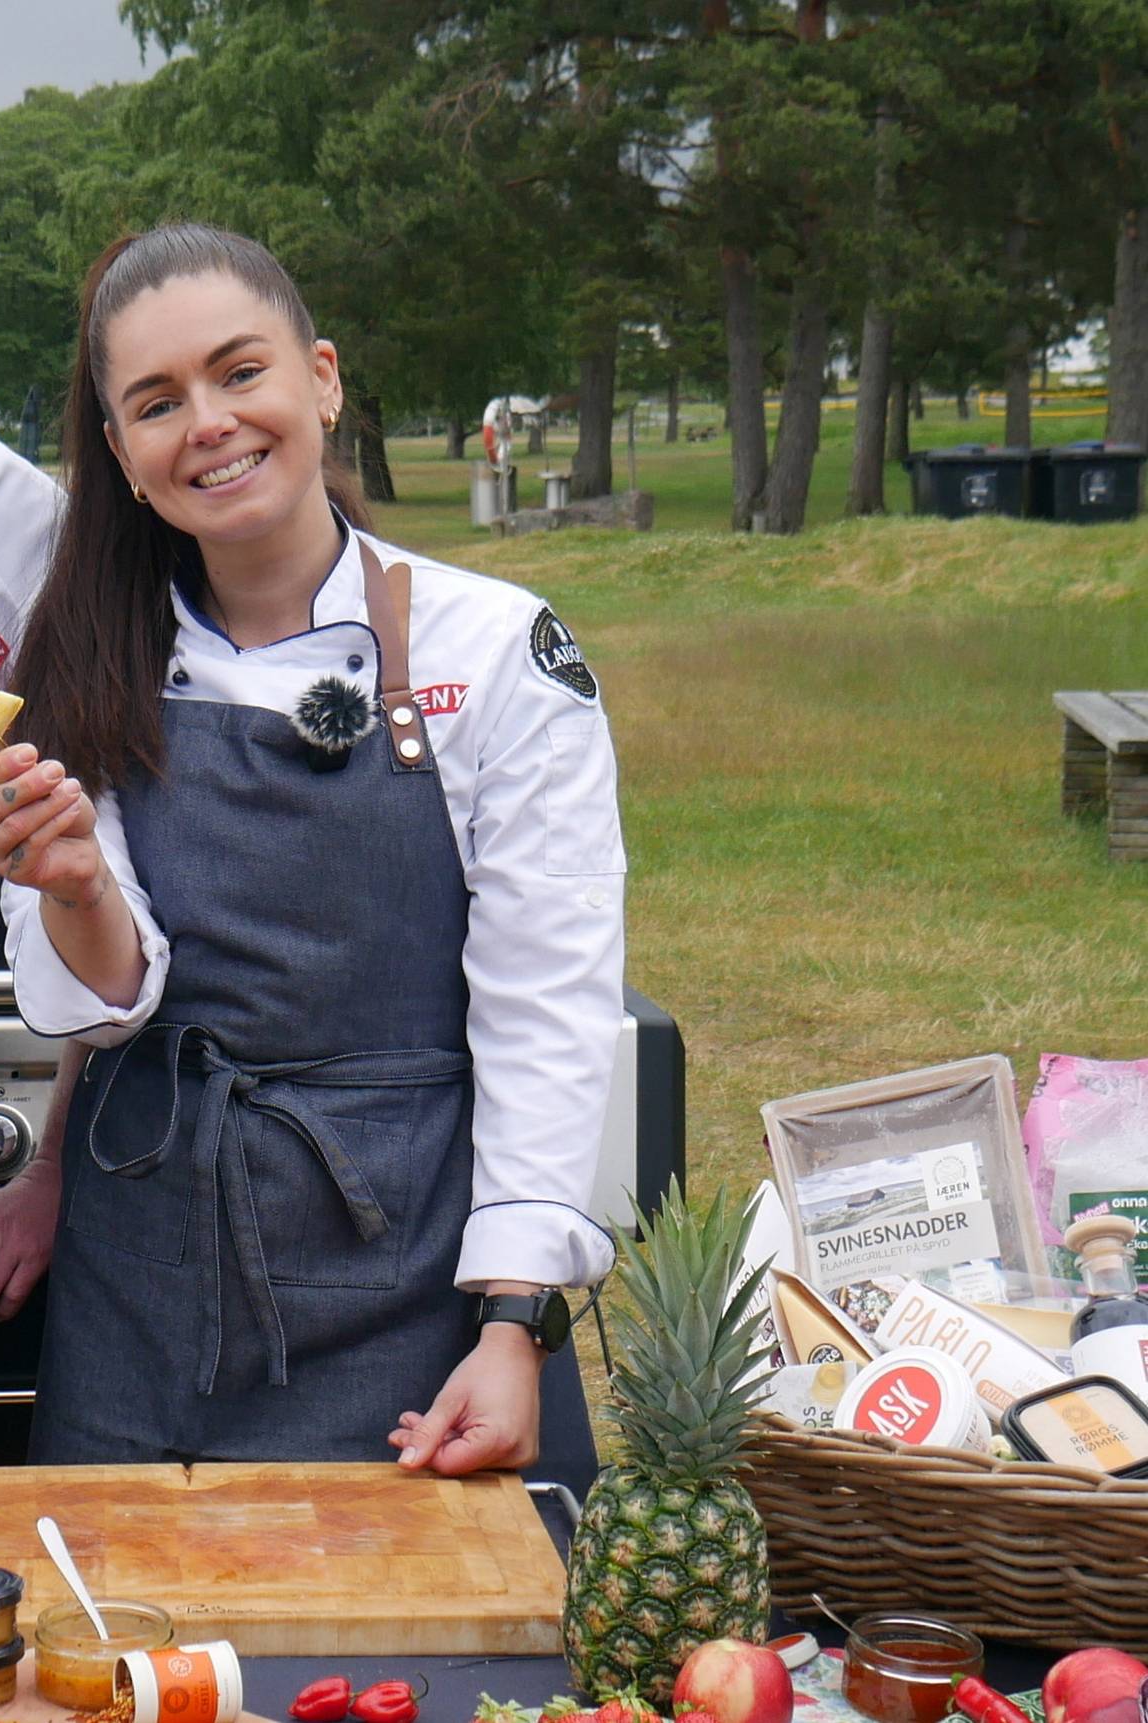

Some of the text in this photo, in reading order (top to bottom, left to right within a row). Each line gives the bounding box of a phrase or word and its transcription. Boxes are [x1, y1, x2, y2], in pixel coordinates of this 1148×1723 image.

[412, 686, 469, 710] ENY
[817, 1212, 969, 1258] SVINESNADDER
[820, 1238, 950, 1273] FLAMMEGRILLET PÅ SPYD
[888, 1295, 992, 1377] PABLO
[868, 1379, 929, 1437] ASK
[1069, 1424, 1119, 1446] RØROS
[1076, 1431, 1129, 1456] RØMME
